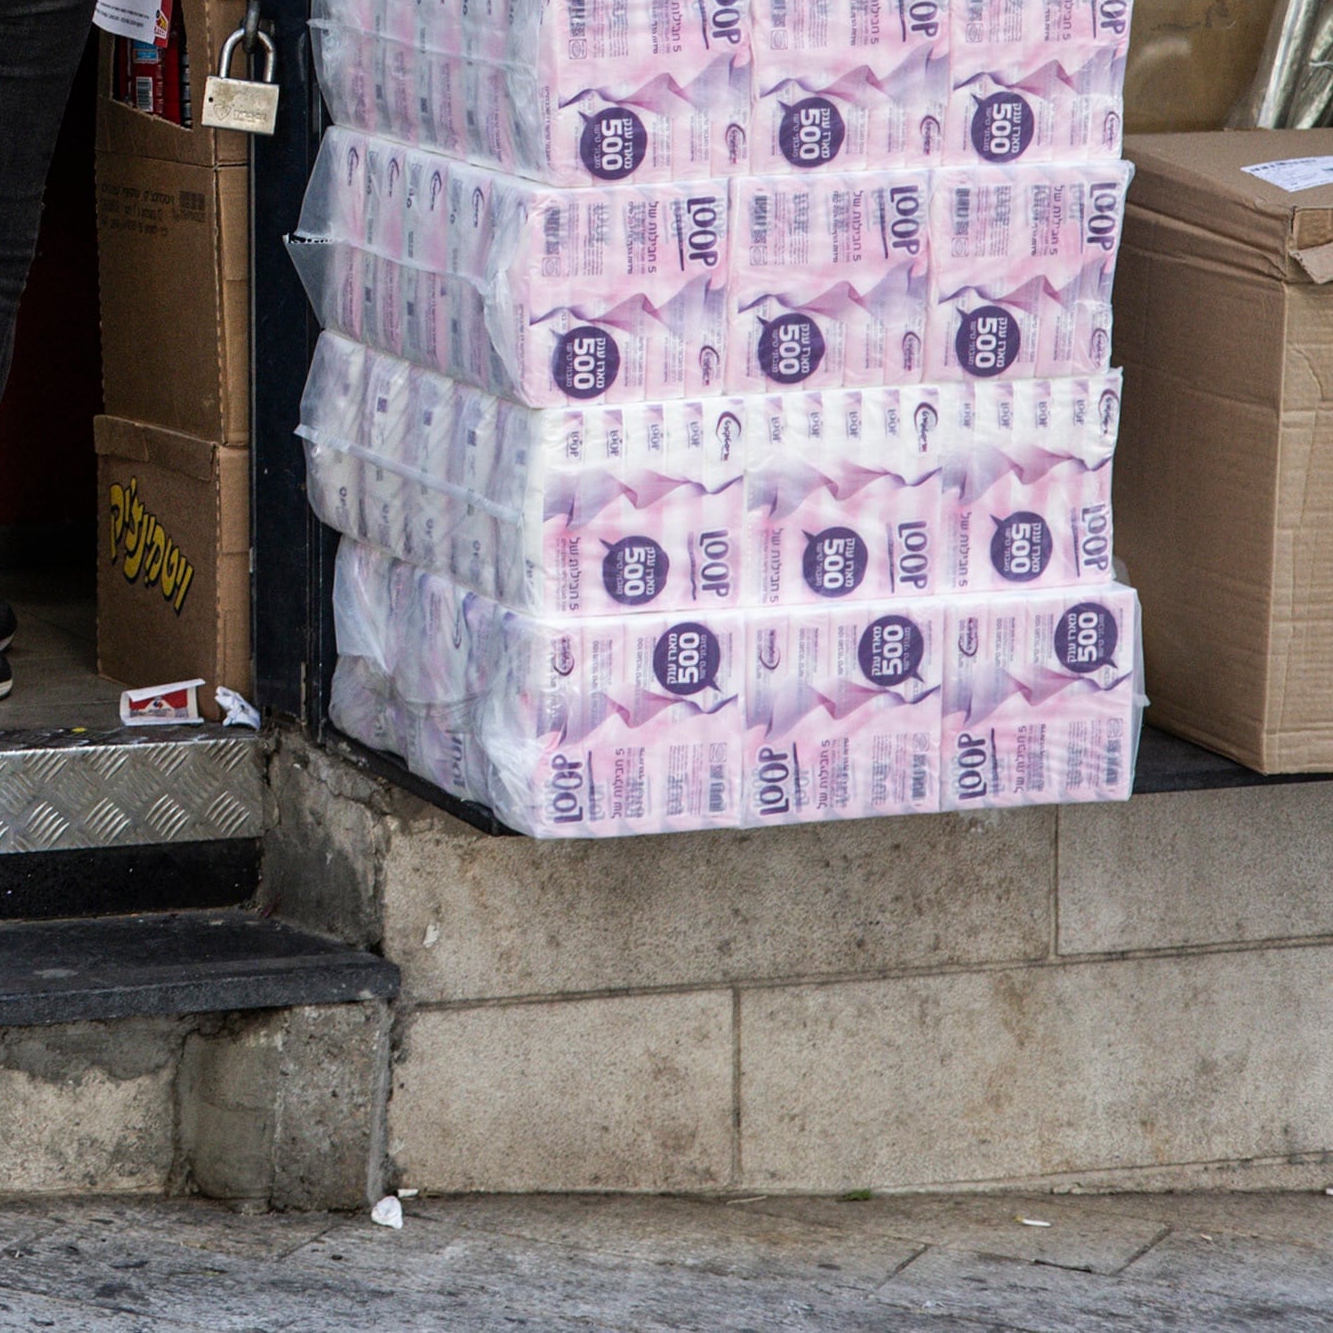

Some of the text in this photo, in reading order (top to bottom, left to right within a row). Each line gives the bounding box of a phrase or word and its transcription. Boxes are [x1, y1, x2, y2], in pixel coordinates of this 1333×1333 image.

[602, 118, 623, 171] 500
[801, 106, 821, 159] 500
[992, 102, 1012, 155] 500
[574, 337, 595, 389] 500
[781, 322, 802, 375] 500
[977, 317, 998, 368] 500
[624, 546, 645, 597] 500
[823, 537, 844, 588] 500
[1011, 522, 1031, 573] 500
[678, 632, 701, 685] 500
[882, 624, 903, 678] 500
[1077, 611, 1098, 663] 500
